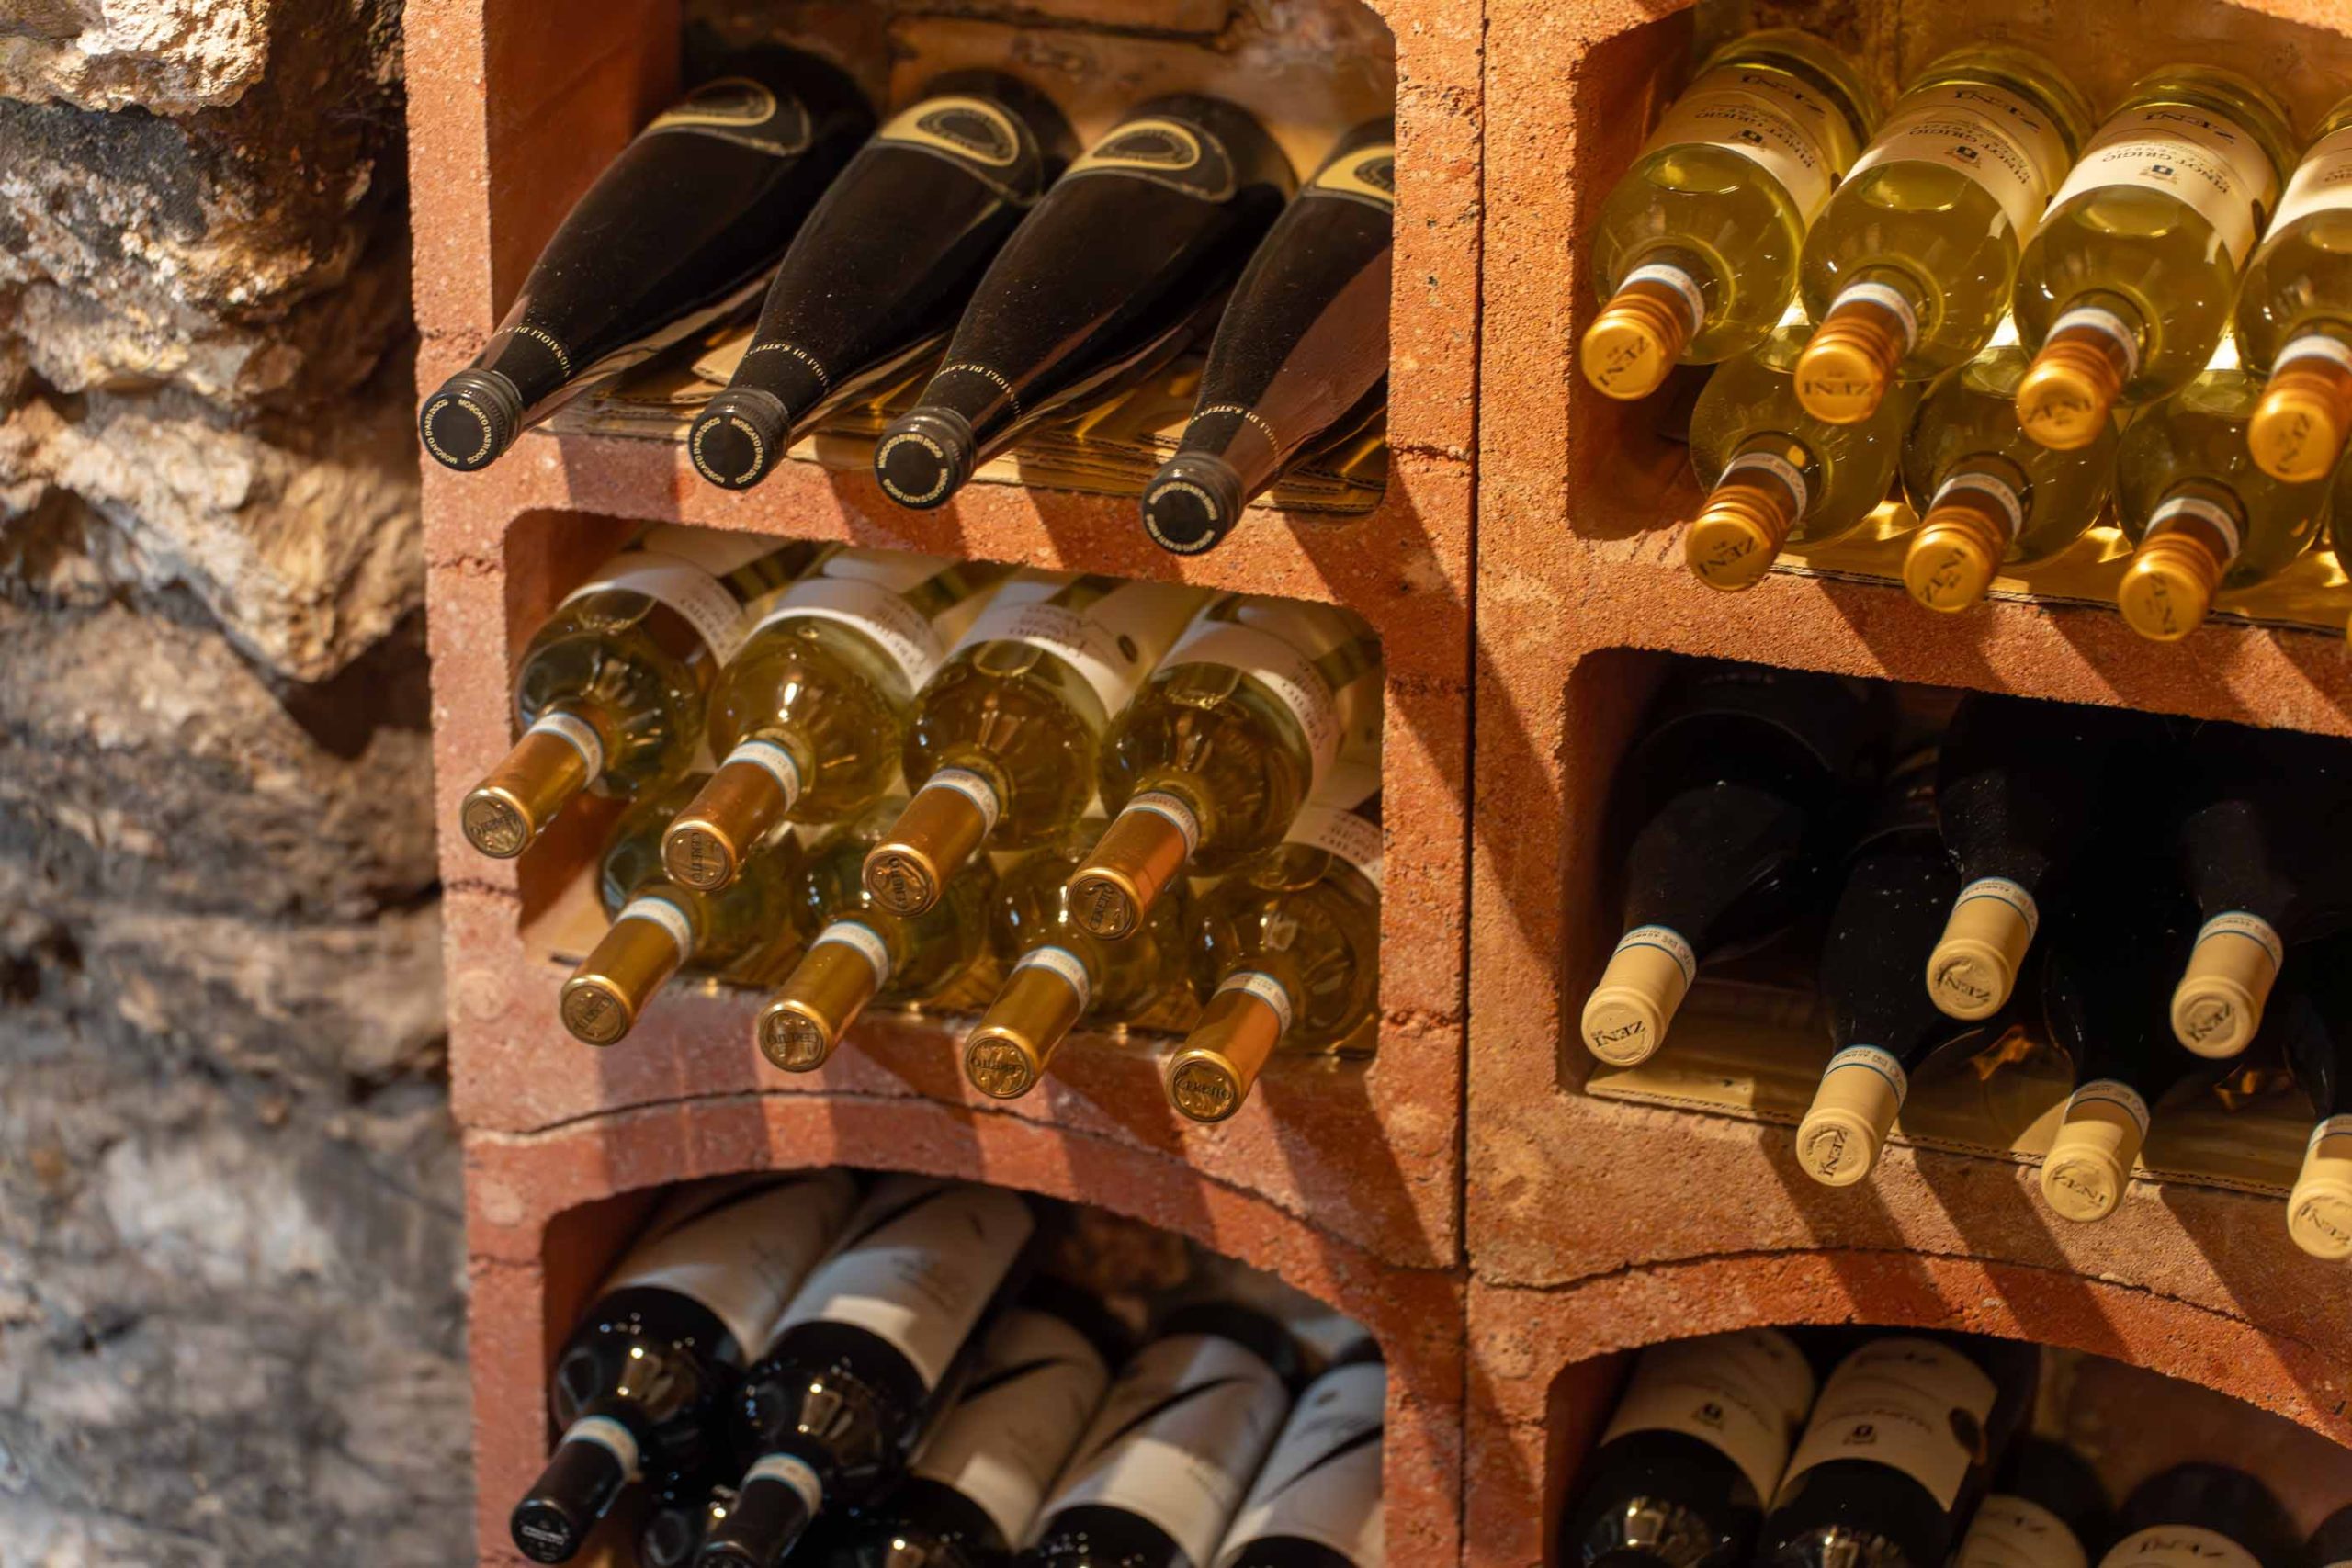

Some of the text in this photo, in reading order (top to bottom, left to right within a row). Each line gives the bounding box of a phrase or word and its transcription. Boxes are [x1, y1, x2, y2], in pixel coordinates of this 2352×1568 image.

[2102, 150, 2172, 163] GRIGIO
[515, 323, 529, 334] DI
[792, 348, 808, 359] DI
[1597, 335, 1650, 386] ZENI
[968, 364, 985, 375] DI
[1804, 380, 1871, 395] ZENI
[428, 399, 449, 414] DOCG
[458, 399, 489, 425] MOSCATO
[1244, 410, 1259, 423] DI
[730, 417, 761, 446] MOSCATO
[429, 437, 458, 465] MOSCATO
[467, 447, 489, 464] DOCG
[695, 455, 726, 484] MOSCATO
[1698, 536, 1756, 576] ZENI
[1934, 971, 1990, 1002] ZENI
[1593, 1021, 1645, 1047] ZENI
[1824, 1128, 1848, 1177] ZENI
[2052, 1175, 2104, 1202] ZENI
